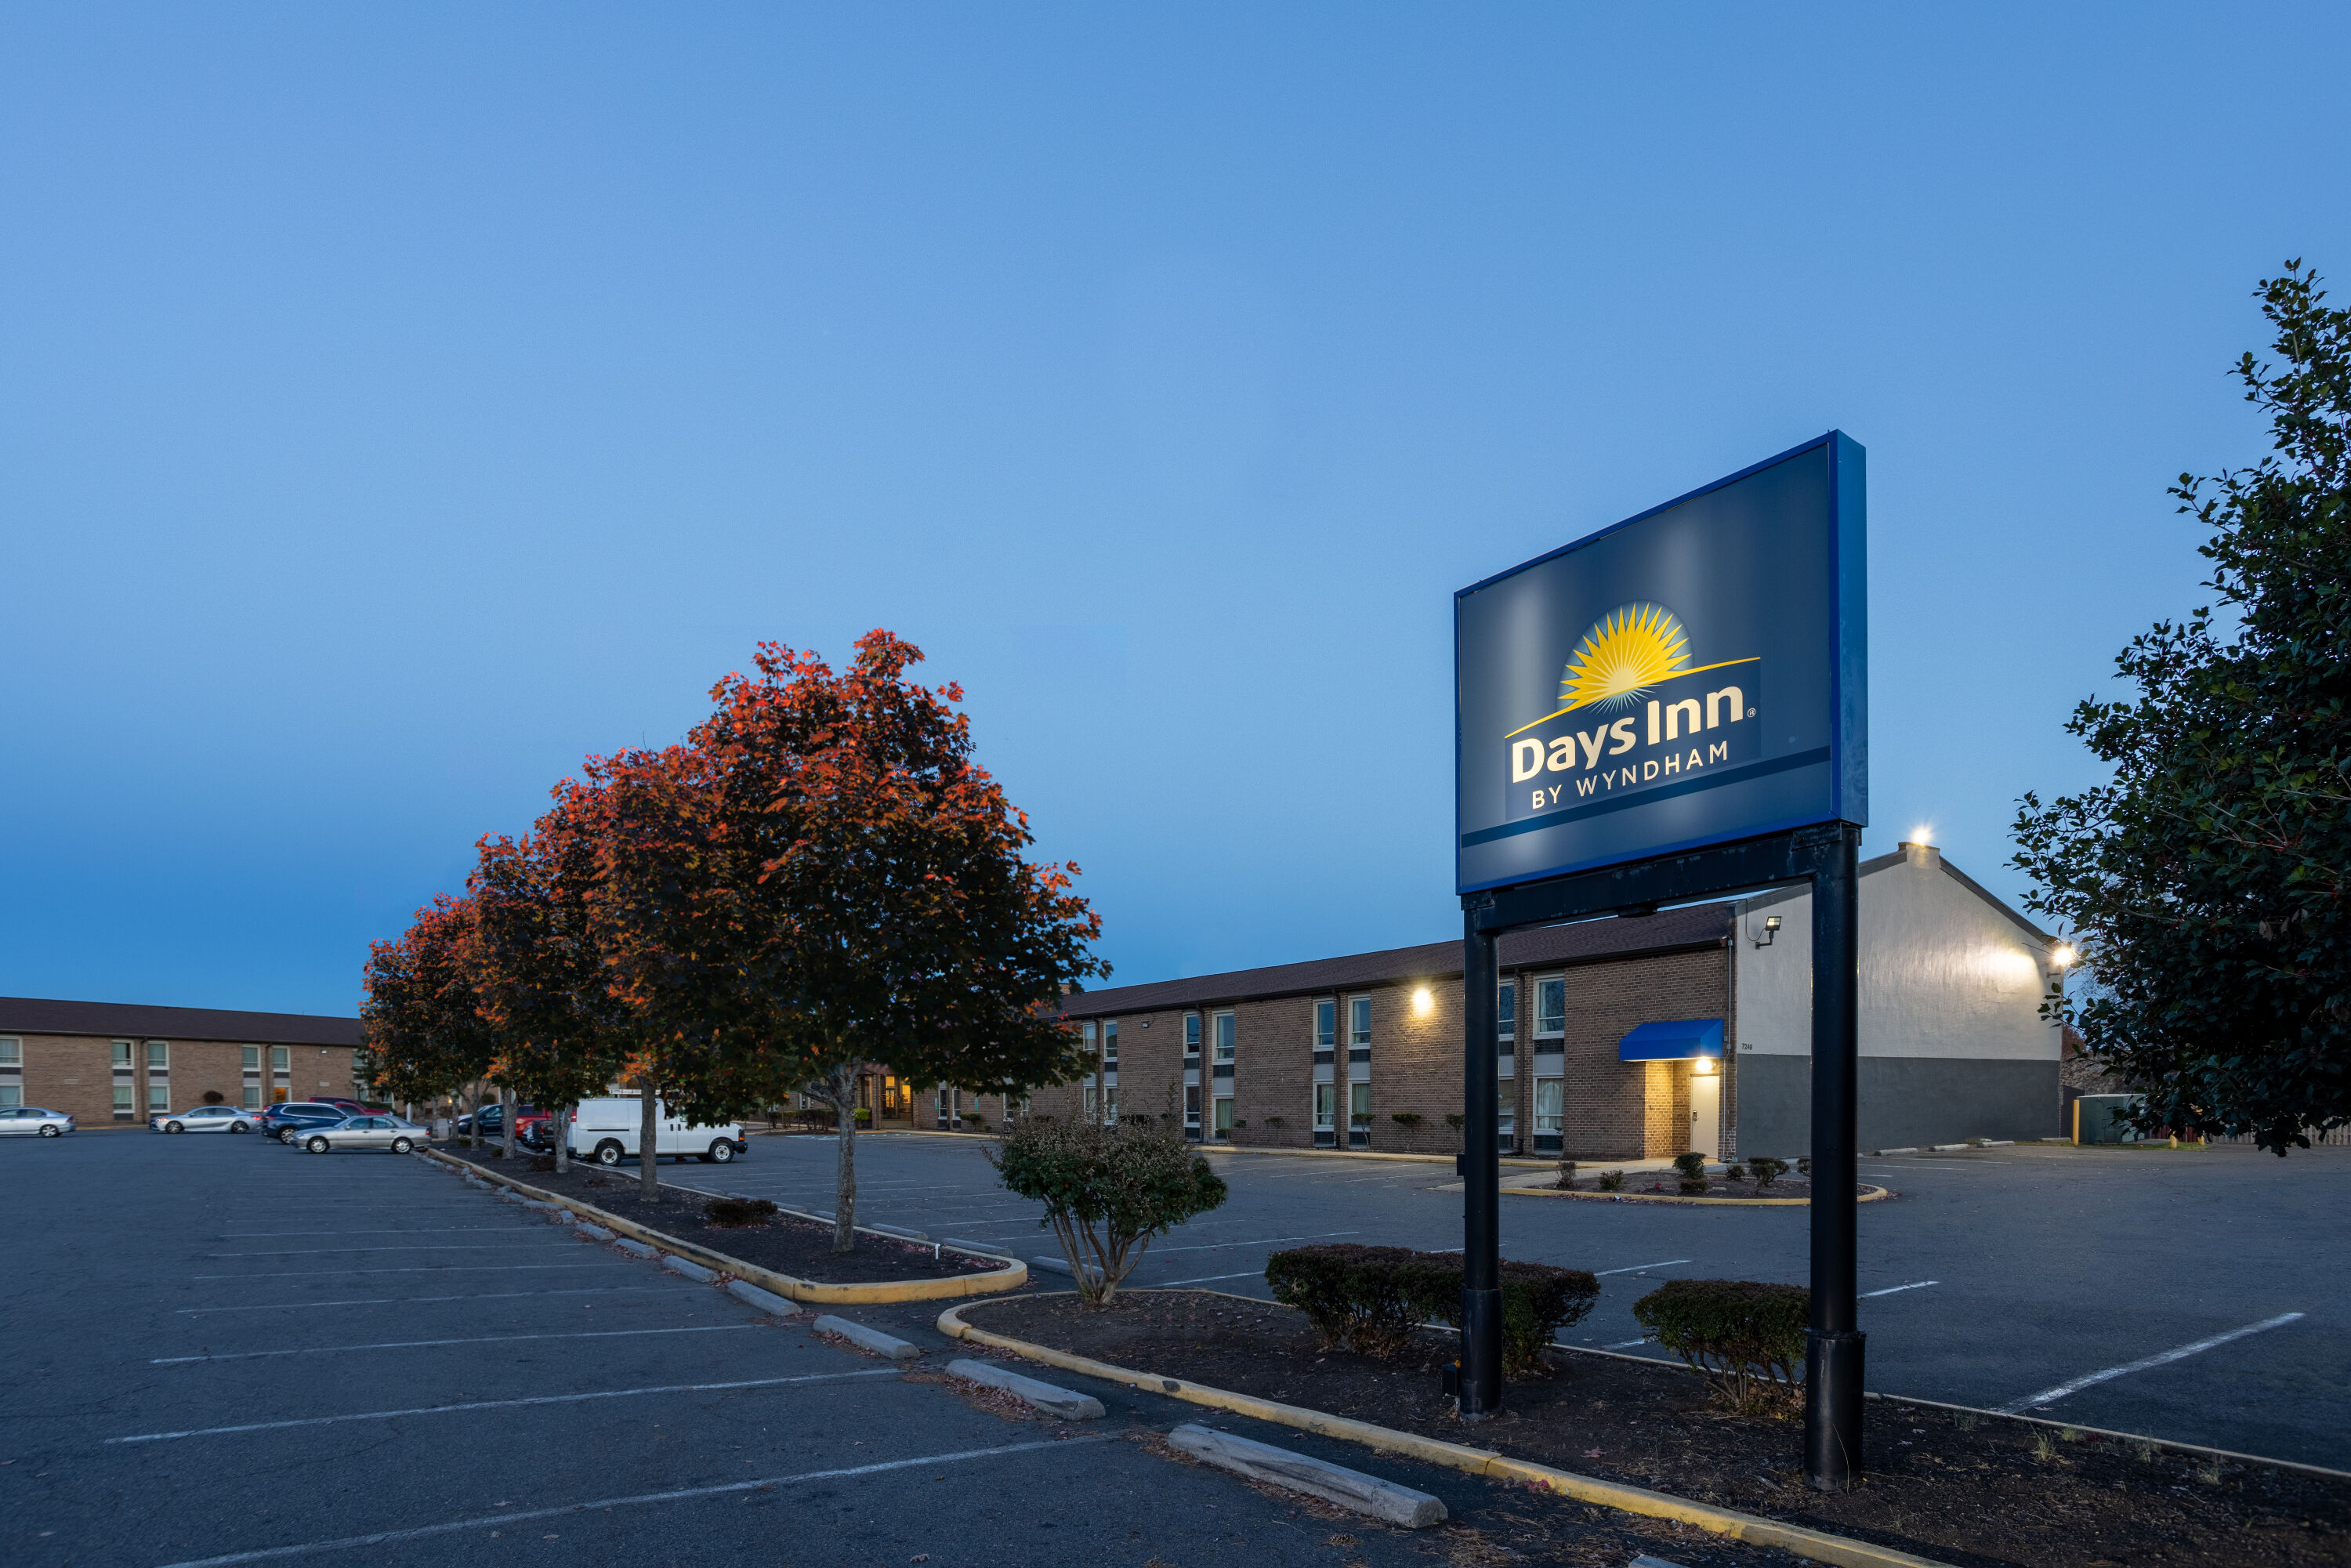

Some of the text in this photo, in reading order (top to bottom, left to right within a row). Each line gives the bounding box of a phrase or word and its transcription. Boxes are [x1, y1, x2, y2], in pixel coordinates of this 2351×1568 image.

[1512, 717, 1636, 784] Days
[1532, 741, 1728, 809] BY WYNDHAM
